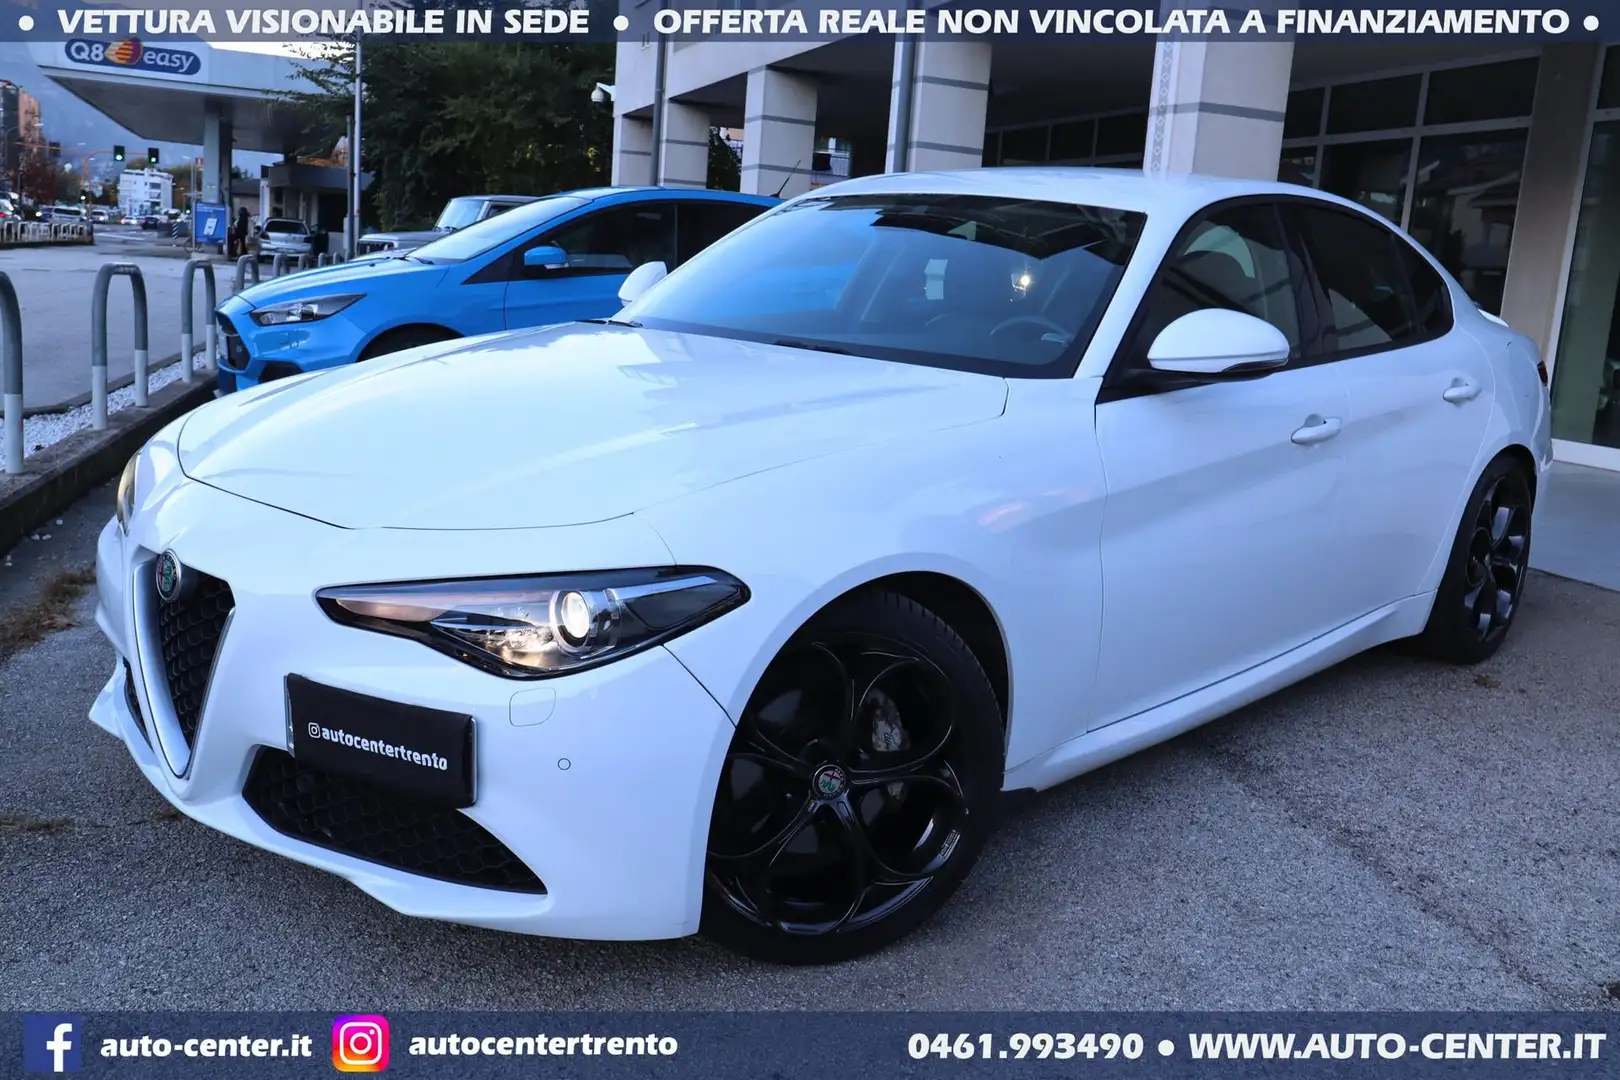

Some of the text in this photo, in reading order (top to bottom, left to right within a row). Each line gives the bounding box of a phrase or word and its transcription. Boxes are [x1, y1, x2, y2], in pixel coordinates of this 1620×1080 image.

[70, 41, 194, 73] Q8 easy
[321, 726, 448, 771] autocentertrento
